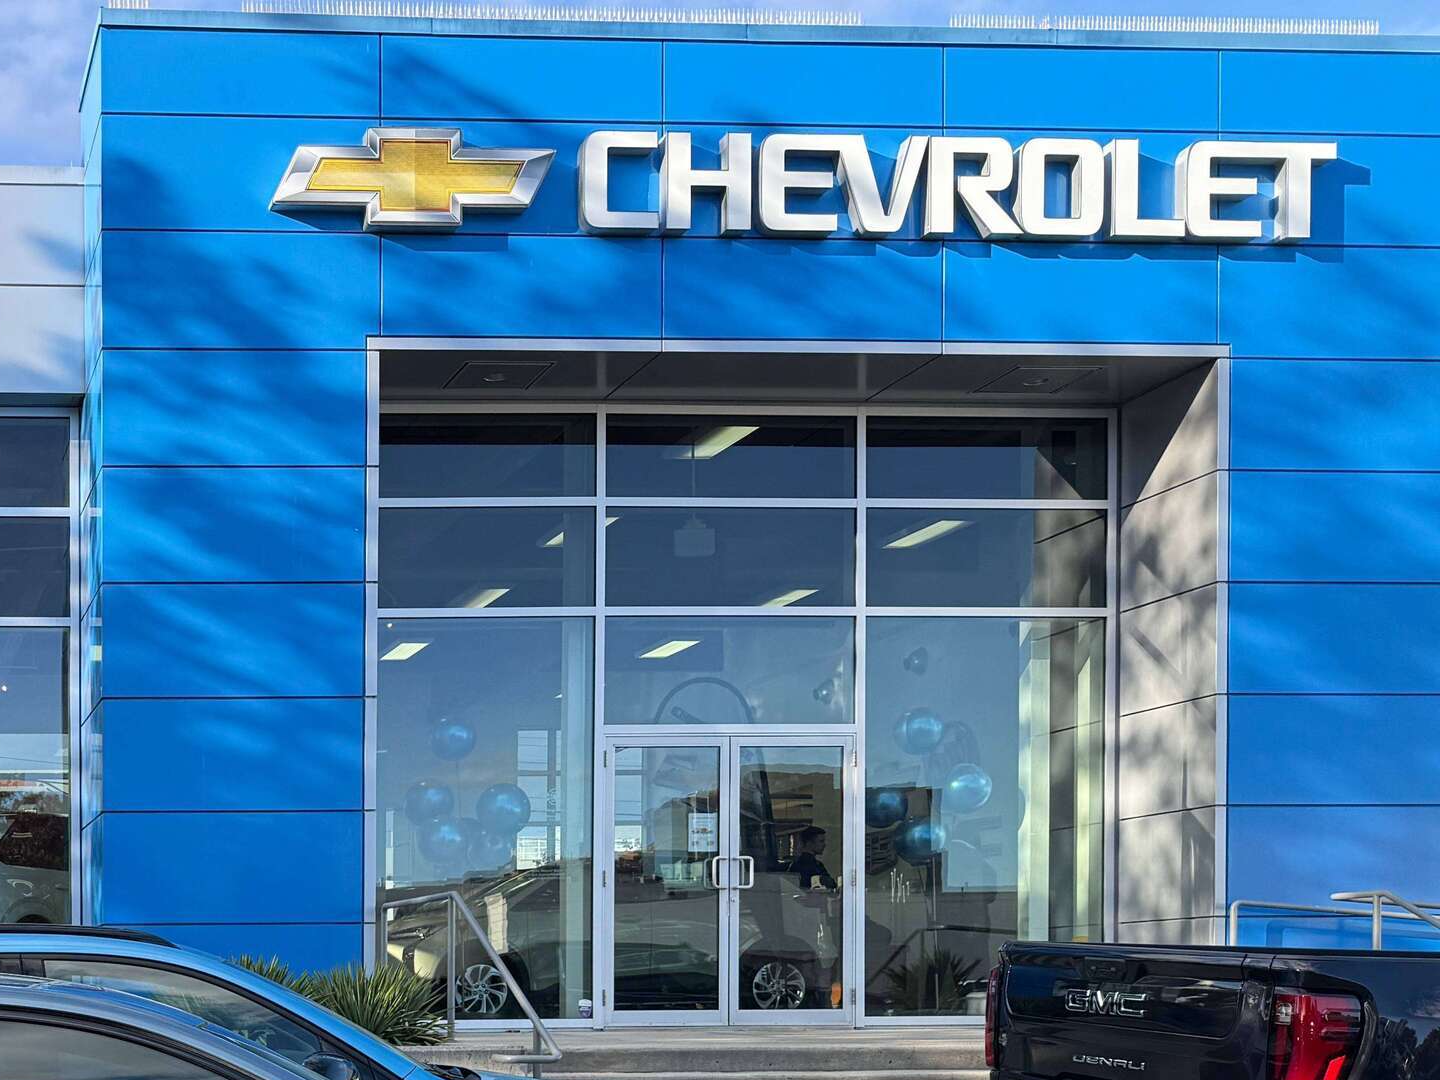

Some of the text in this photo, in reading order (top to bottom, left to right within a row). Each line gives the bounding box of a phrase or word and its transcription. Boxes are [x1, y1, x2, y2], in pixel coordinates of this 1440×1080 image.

[579, 130, 1337, 241] CHEVROLET
[1065, 988, 1146, 1018] GMC
[1072, 1055, 1145, 1071] DENALI
